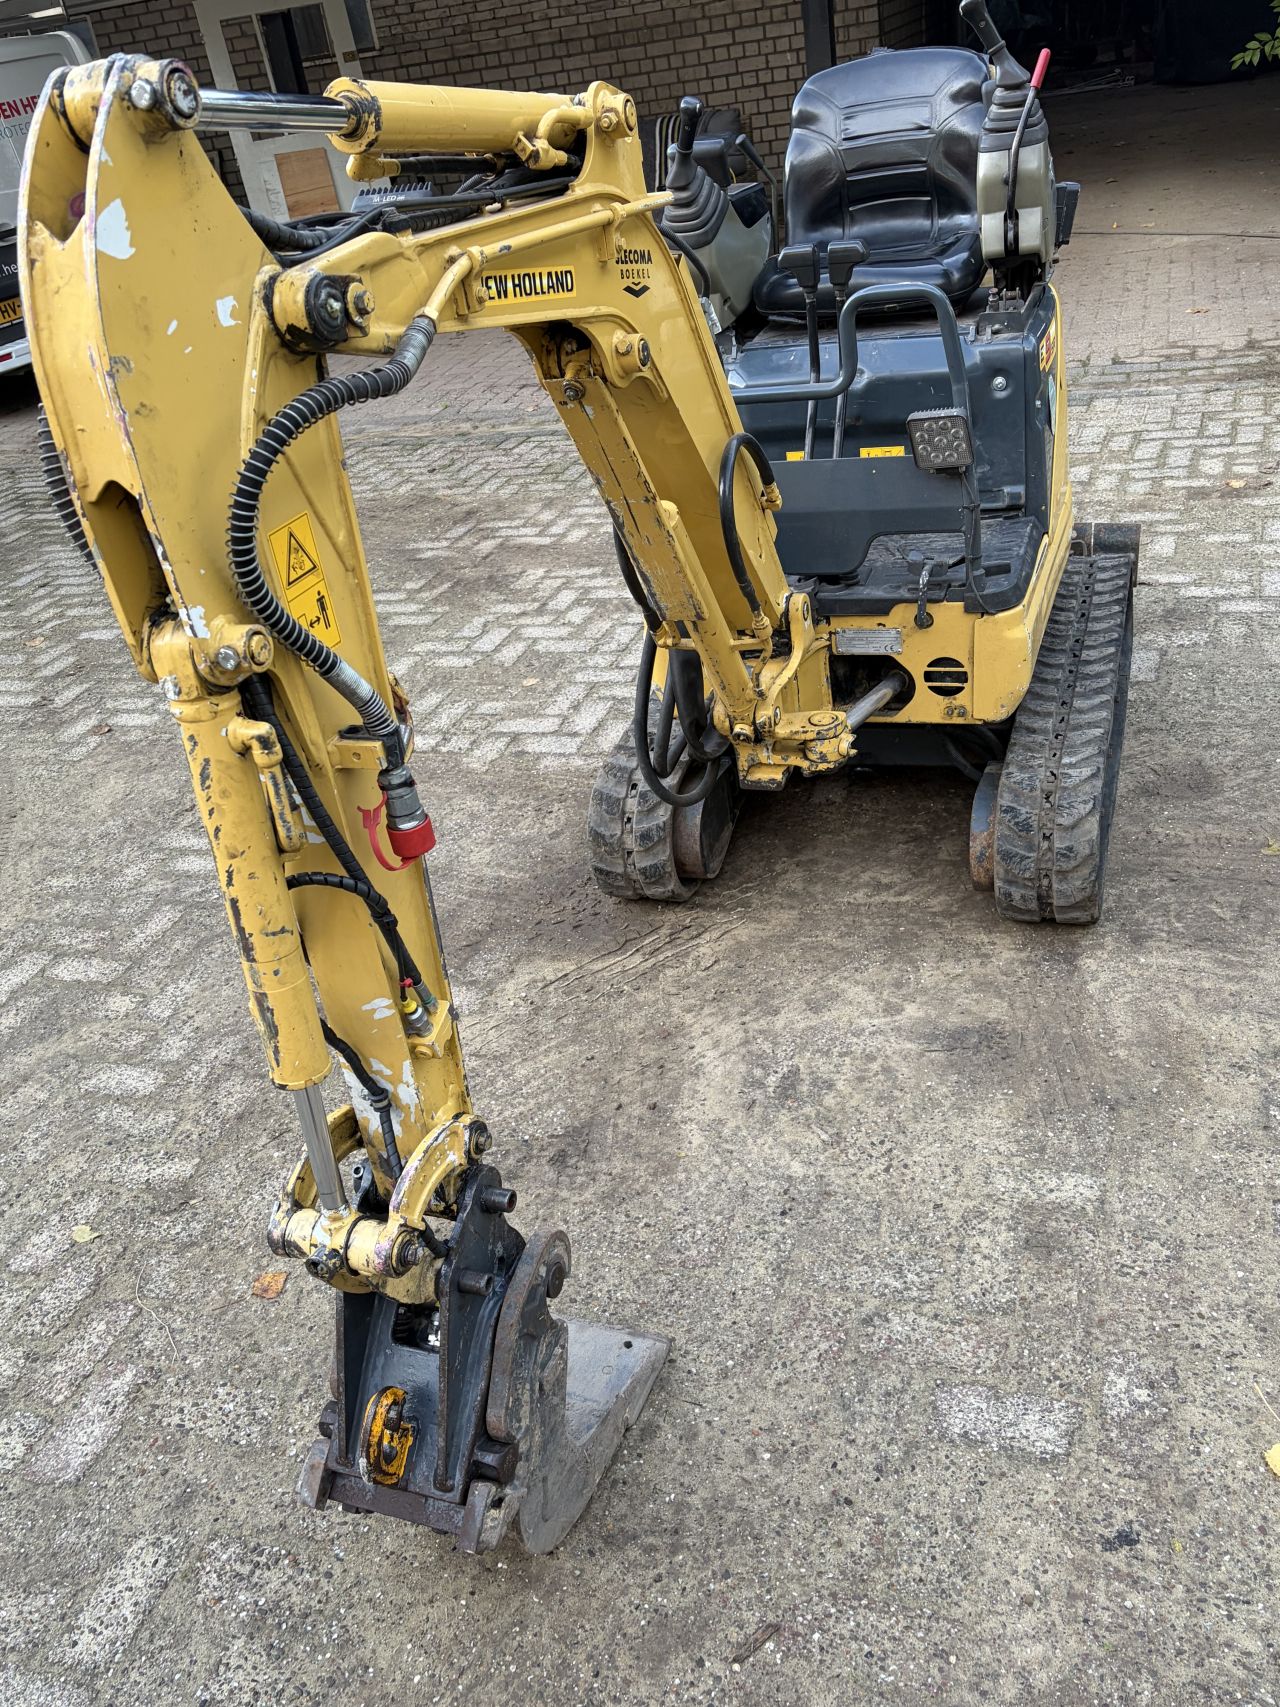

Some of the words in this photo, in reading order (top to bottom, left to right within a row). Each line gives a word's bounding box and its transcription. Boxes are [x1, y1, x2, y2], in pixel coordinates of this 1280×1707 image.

[620, 268, 651, 280] BOEKEL
[481, 274, 508, 300] EW
[511, 270, 574, 298] HOLLAND
